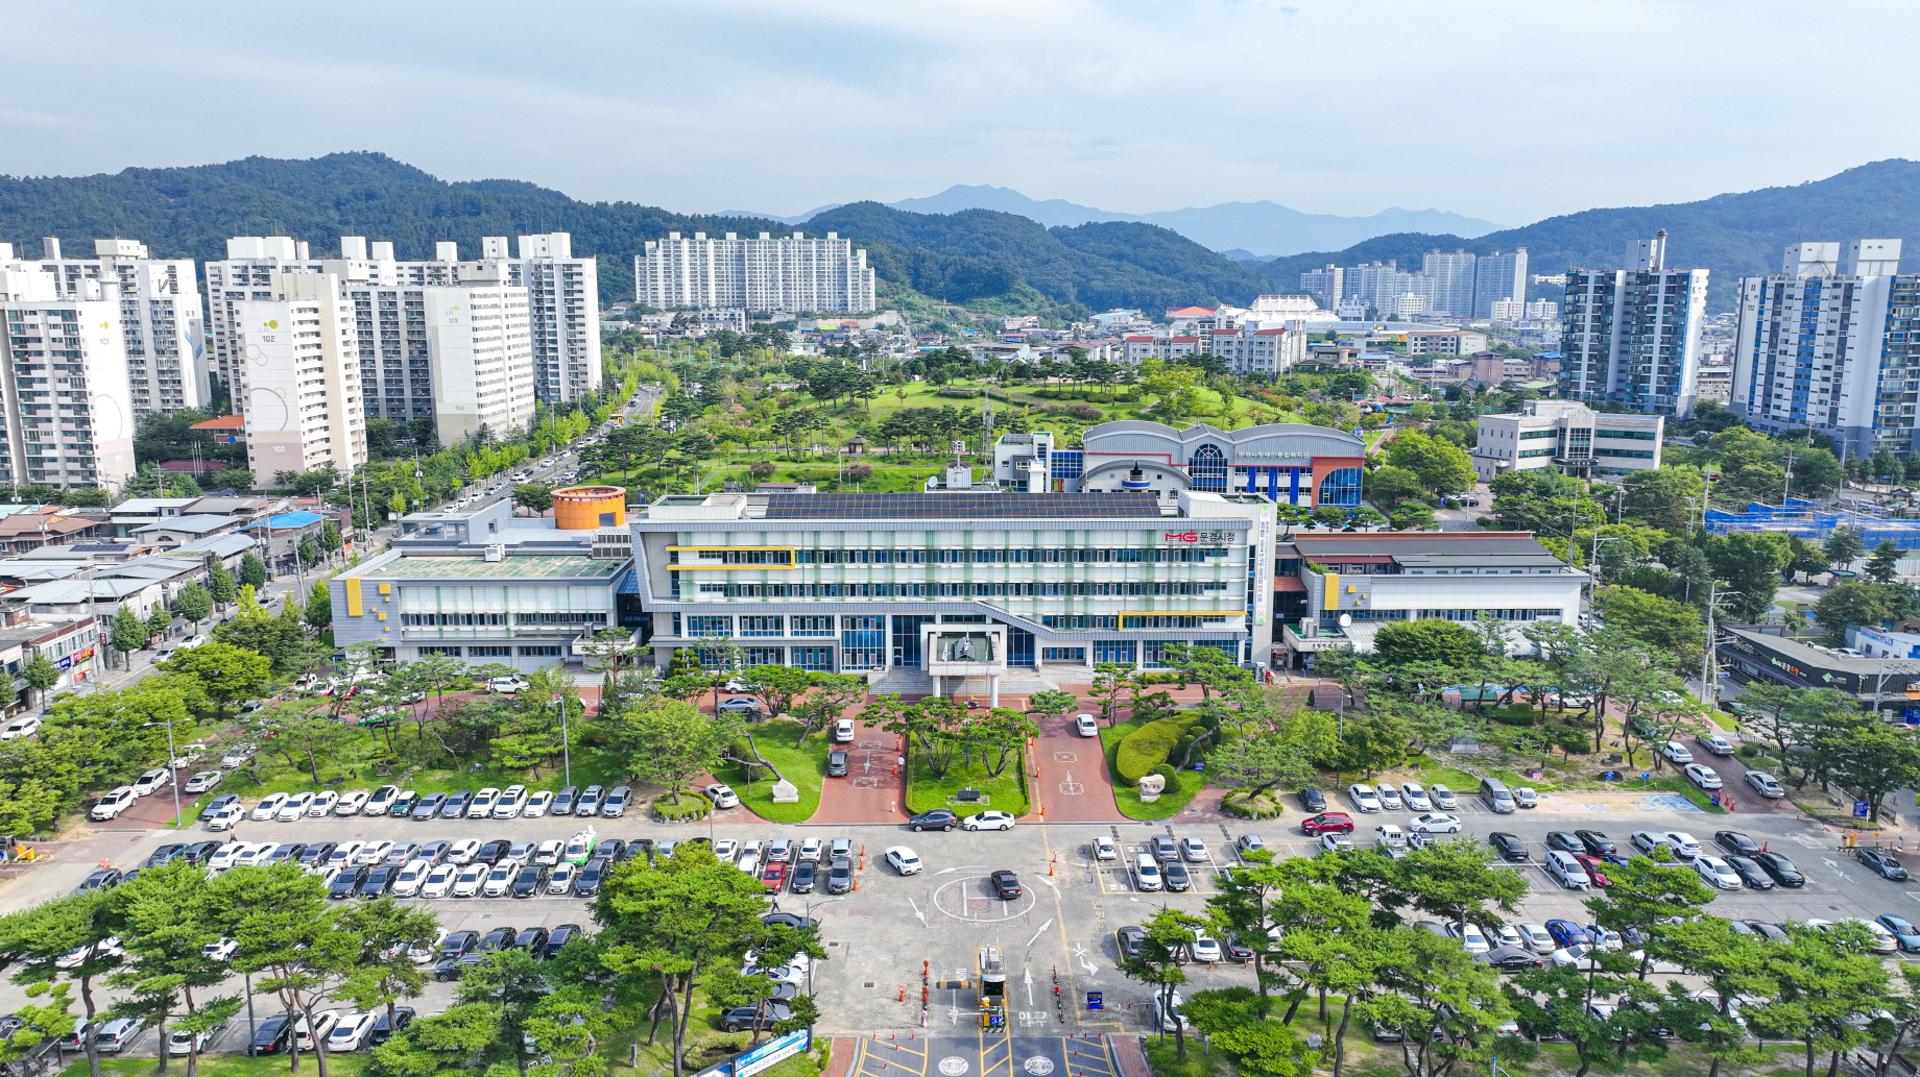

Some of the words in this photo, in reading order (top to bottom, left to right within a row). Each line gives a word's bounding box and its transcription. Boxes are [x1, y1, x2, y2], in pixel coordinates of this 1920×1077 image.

[262, 335, 276, 343] 102
[1165, 532, 1198, 542] MG
[1199, 532, 1235, 543] 문경시청
